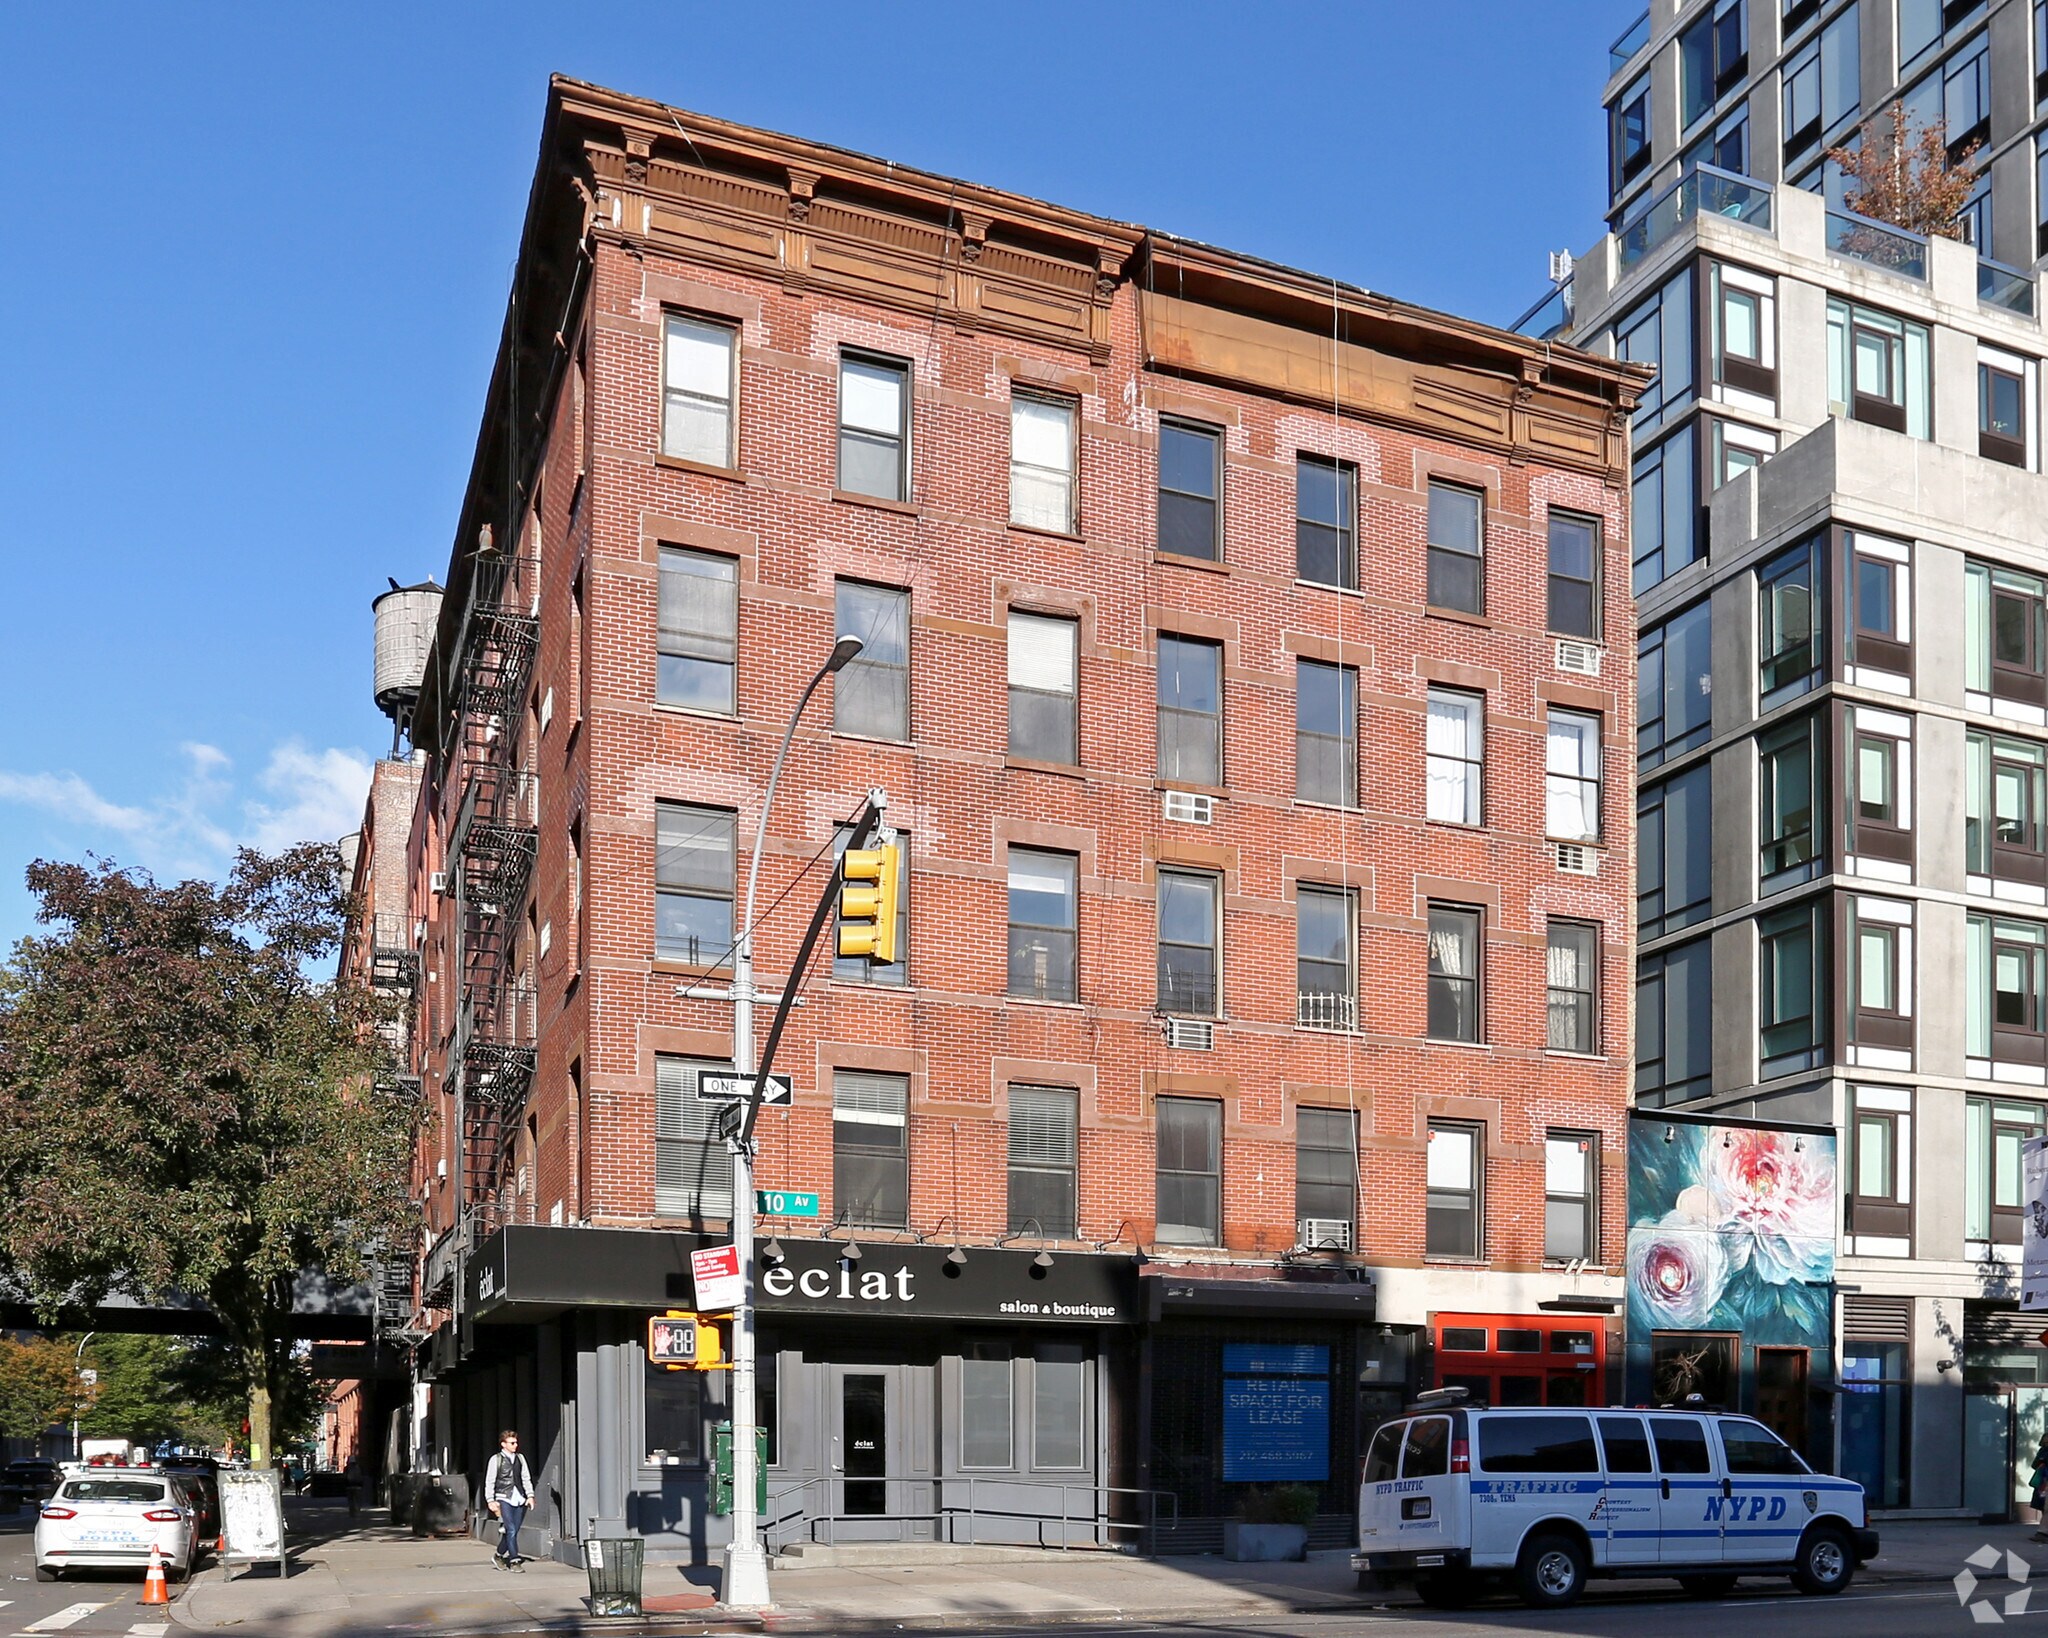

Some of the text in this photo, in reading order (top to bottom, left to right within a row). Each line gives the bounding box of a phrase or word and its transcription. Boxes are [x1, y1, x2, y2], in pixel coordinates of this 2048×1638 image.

[711, 1079, 738, 1093] ONE
[764, 1193, 809, 1212] 10 Av
[1000, 1301, 1116, 1318] salon & boutique
[1246, 1380, 1307, 1392] RETAIL
[1230, 1394, 1323, 1409] SPACE FOR
[1248, 1410, 1304, 1424] LEASE
[1375, 1479, 1425, 1496] NYPD TRAFFIC
[1487, 1481, 1579, 1494] TRAFFIC
[1703, 1496, 1787, 1521] NYPD
